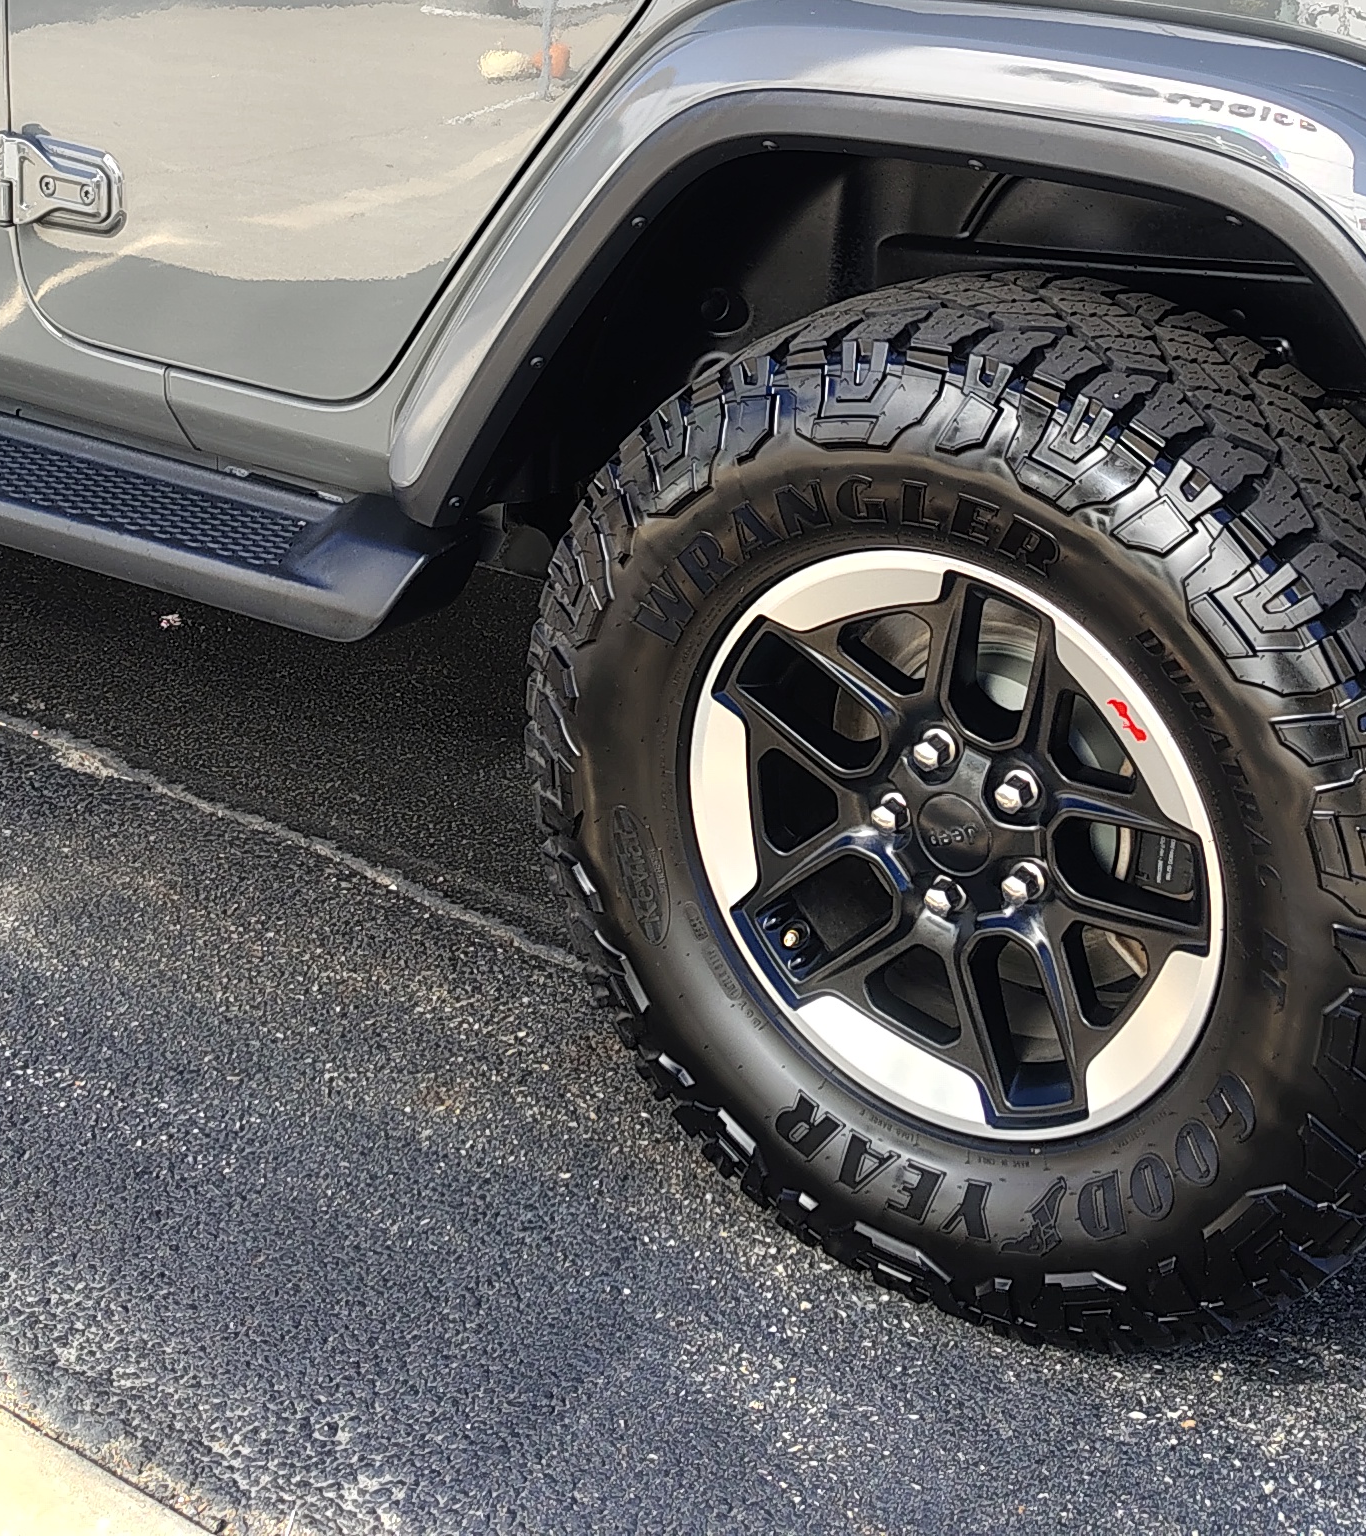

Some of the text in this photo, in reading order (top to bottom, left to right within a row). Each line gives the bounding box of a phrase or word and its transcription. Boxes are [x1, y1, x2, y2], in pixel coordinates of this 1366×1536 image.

[632, 473, 1061, 645] WRANGLER
[1135, 627, 1284, 893] DURATRAC
[618, 829, 661, 924] Kevlar
[775, 1070, 1257, 1243] GOODYEAR
